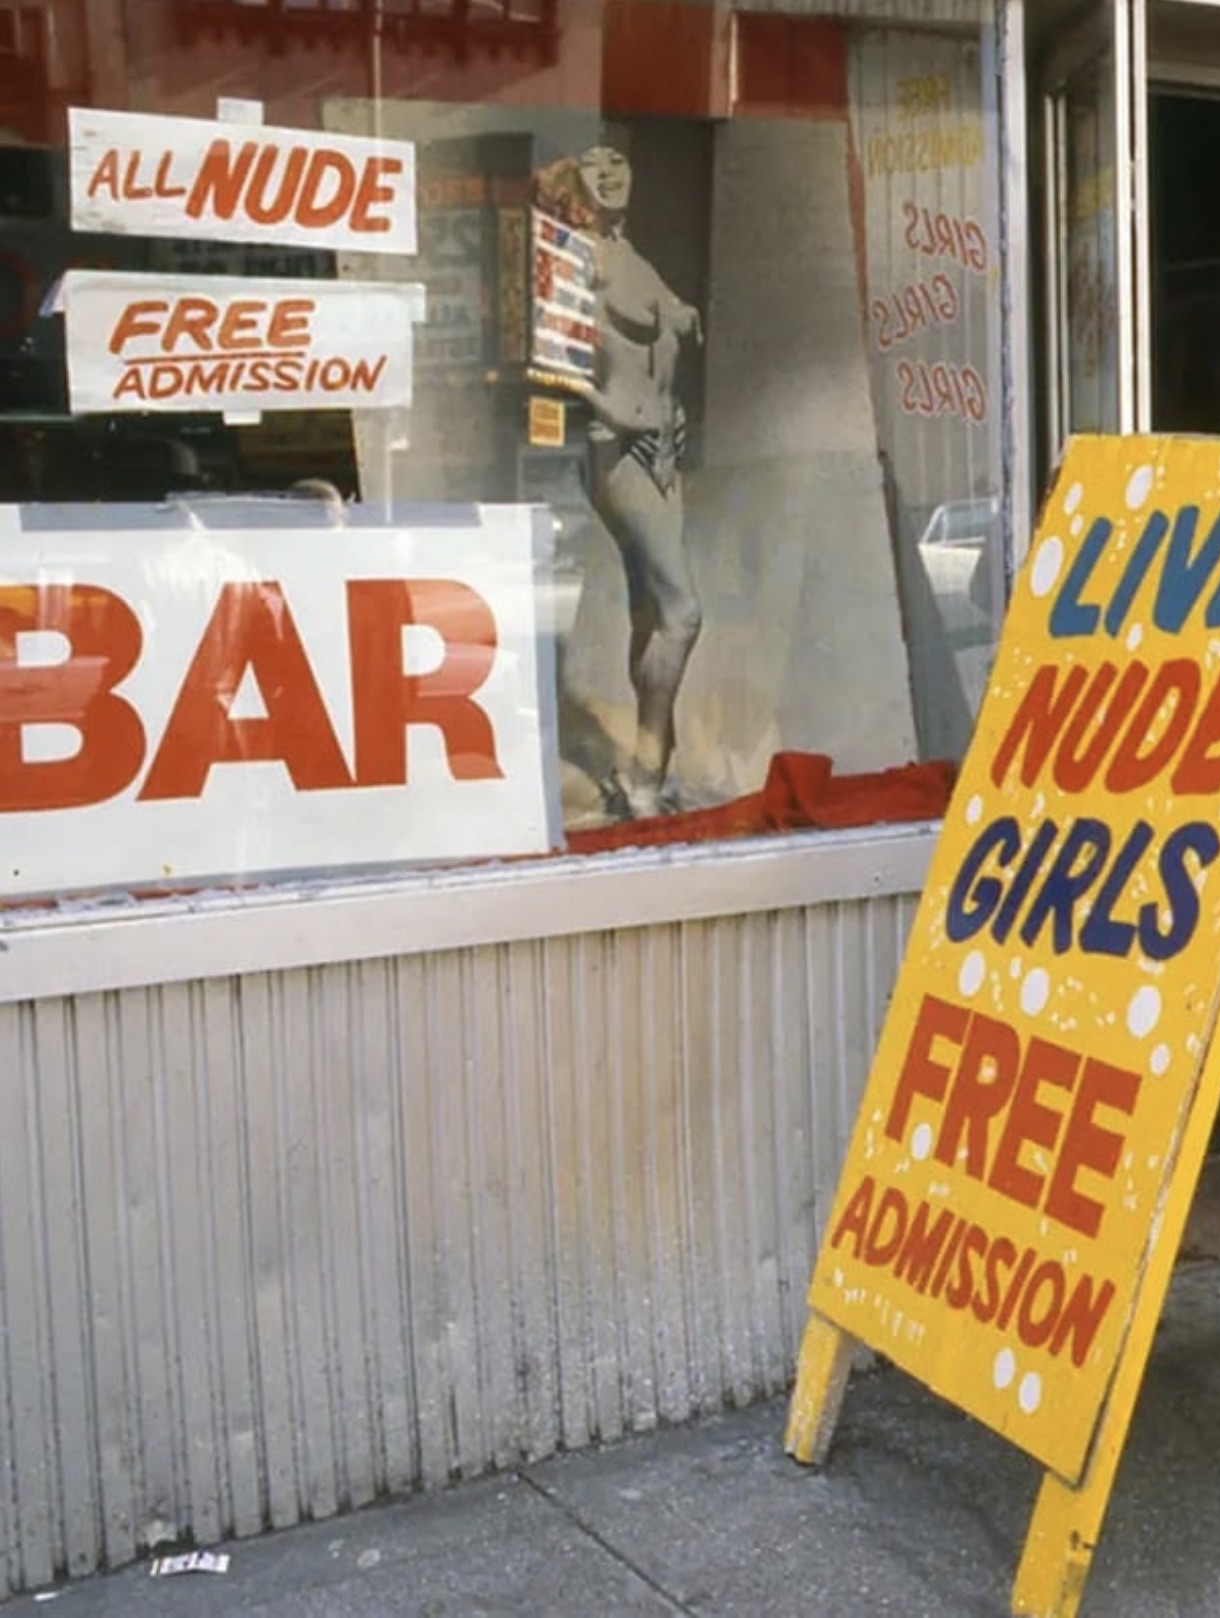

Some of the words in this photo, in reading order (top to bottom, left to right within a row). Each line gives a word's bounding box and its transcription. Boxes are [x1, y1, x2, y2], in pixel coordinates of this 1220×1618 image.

[88, 149, 187, 199] ALL
[186, 140, 402, 232] NUDE
[109, 298, 315, 354] FREE
[113, 355, 388, 399] ADMISSION
[0, 579, 505, 813] BAR
[884, 993, 1143, 1240] FREE
[831, 1175, 1116, 1369] ADMISSION
